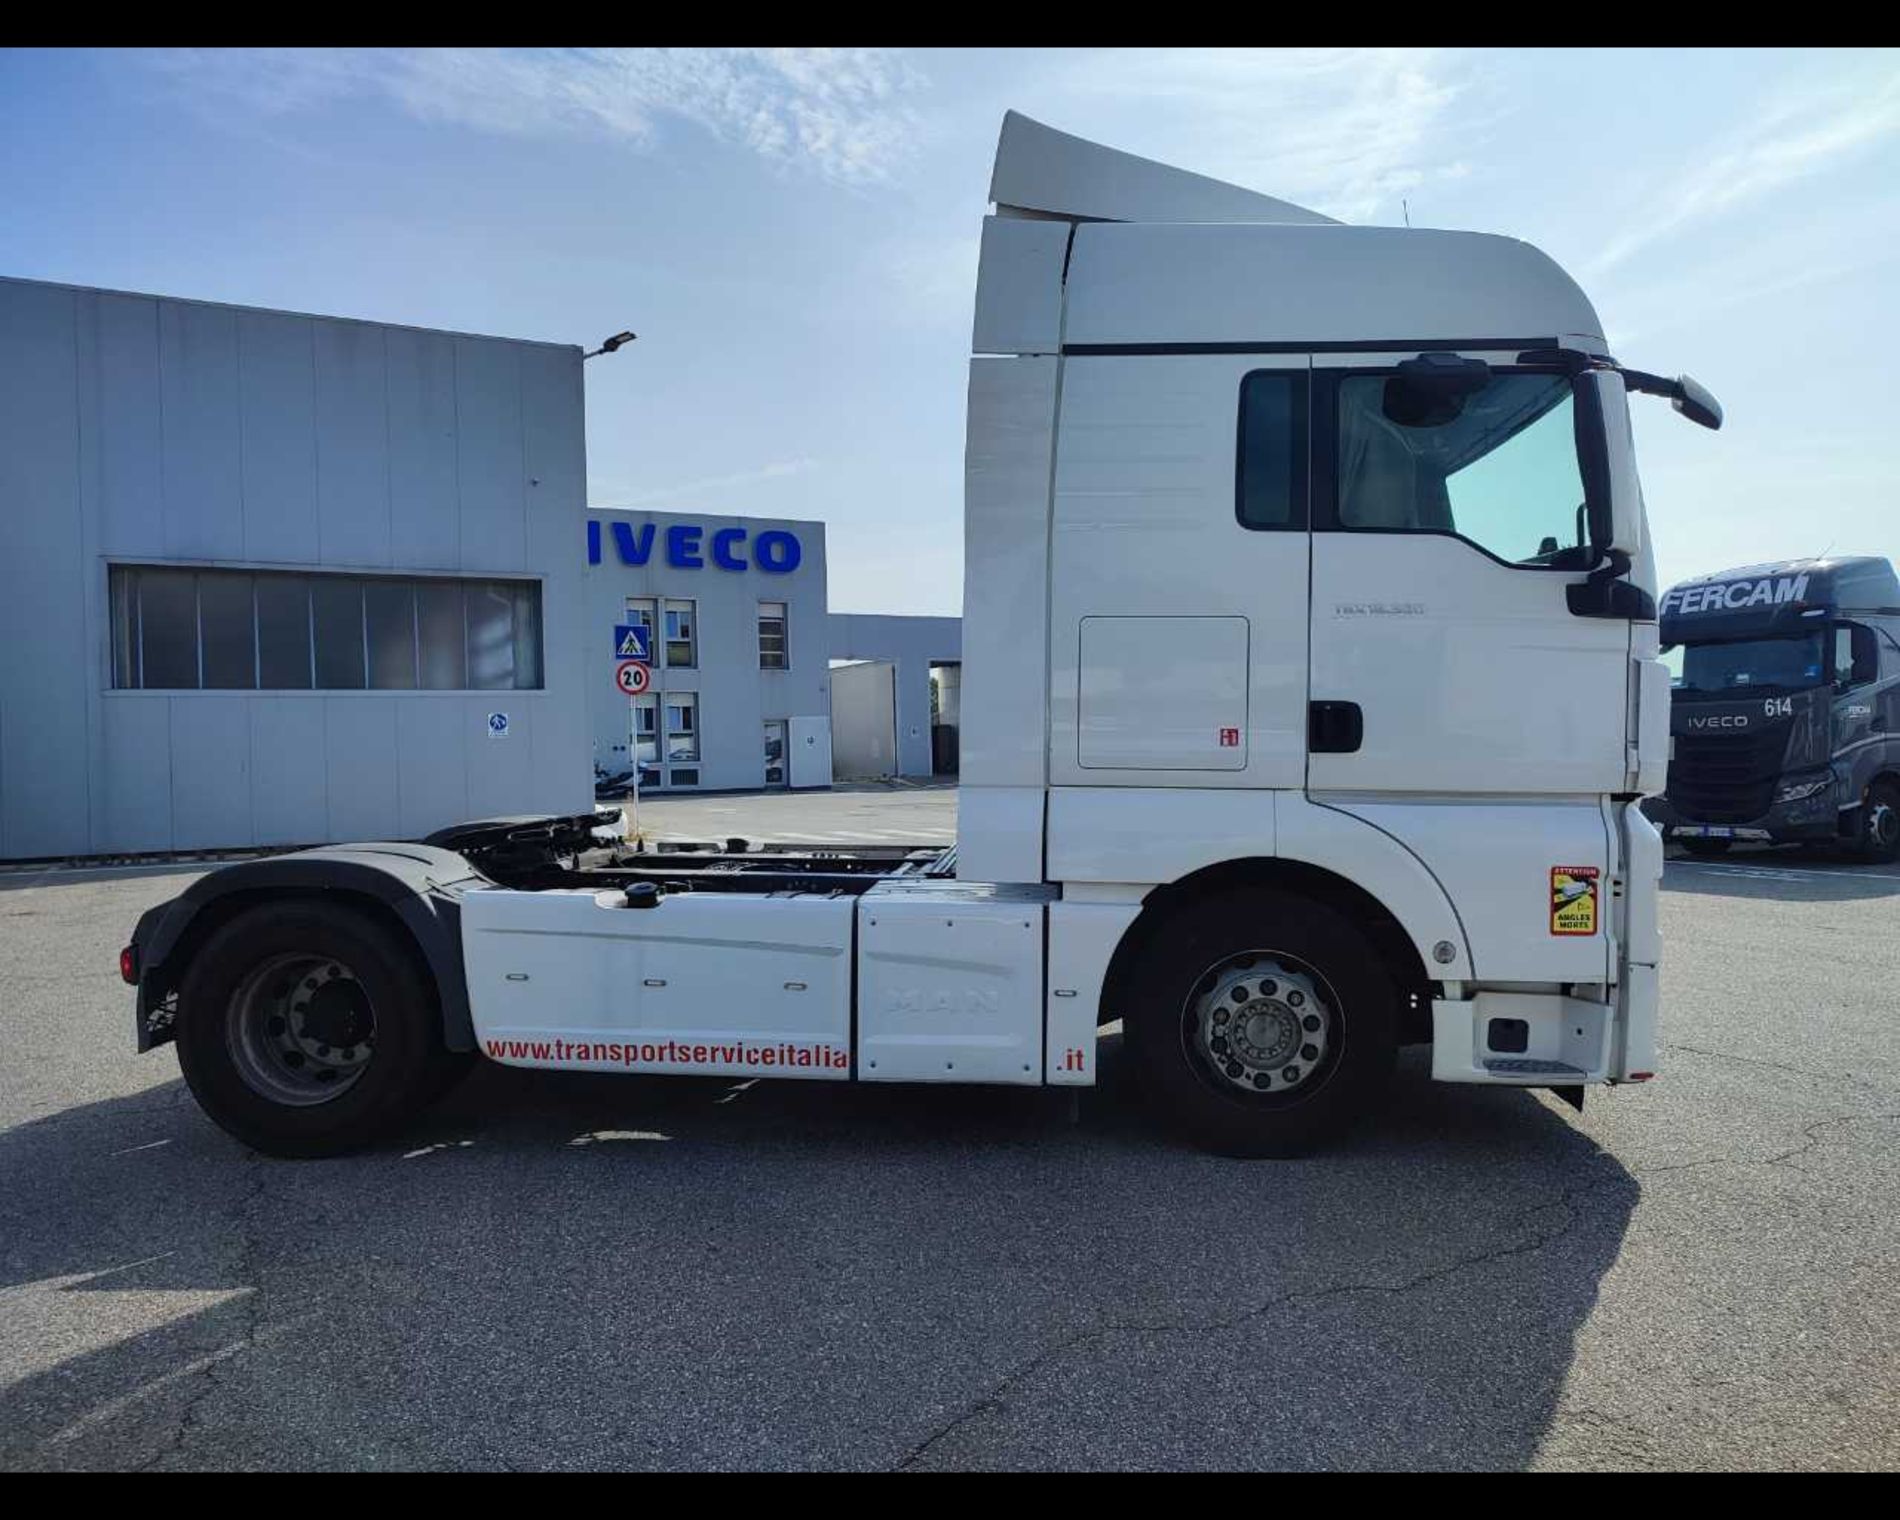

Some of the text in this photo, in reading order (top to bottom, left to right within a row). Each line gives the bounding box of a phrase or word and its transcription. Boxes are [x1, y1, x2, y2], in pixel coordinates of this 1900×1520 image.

[587, 520, 801, 573] IVECO
[1660, 575, 1809, 615] FERCAM
[623, 670, 643, 687] 20
[1764, 697, 1793, 717] 614
[1688, 715, 1748, 729] IVECO
[1558, 913, 1591, 921] ANGLES
[1559, 921, 1590, 929] MORTS
[886, 985, 1001, 1013] MAN
[485, 1038, 1084, 1072] www.transportserviceitalia .it
